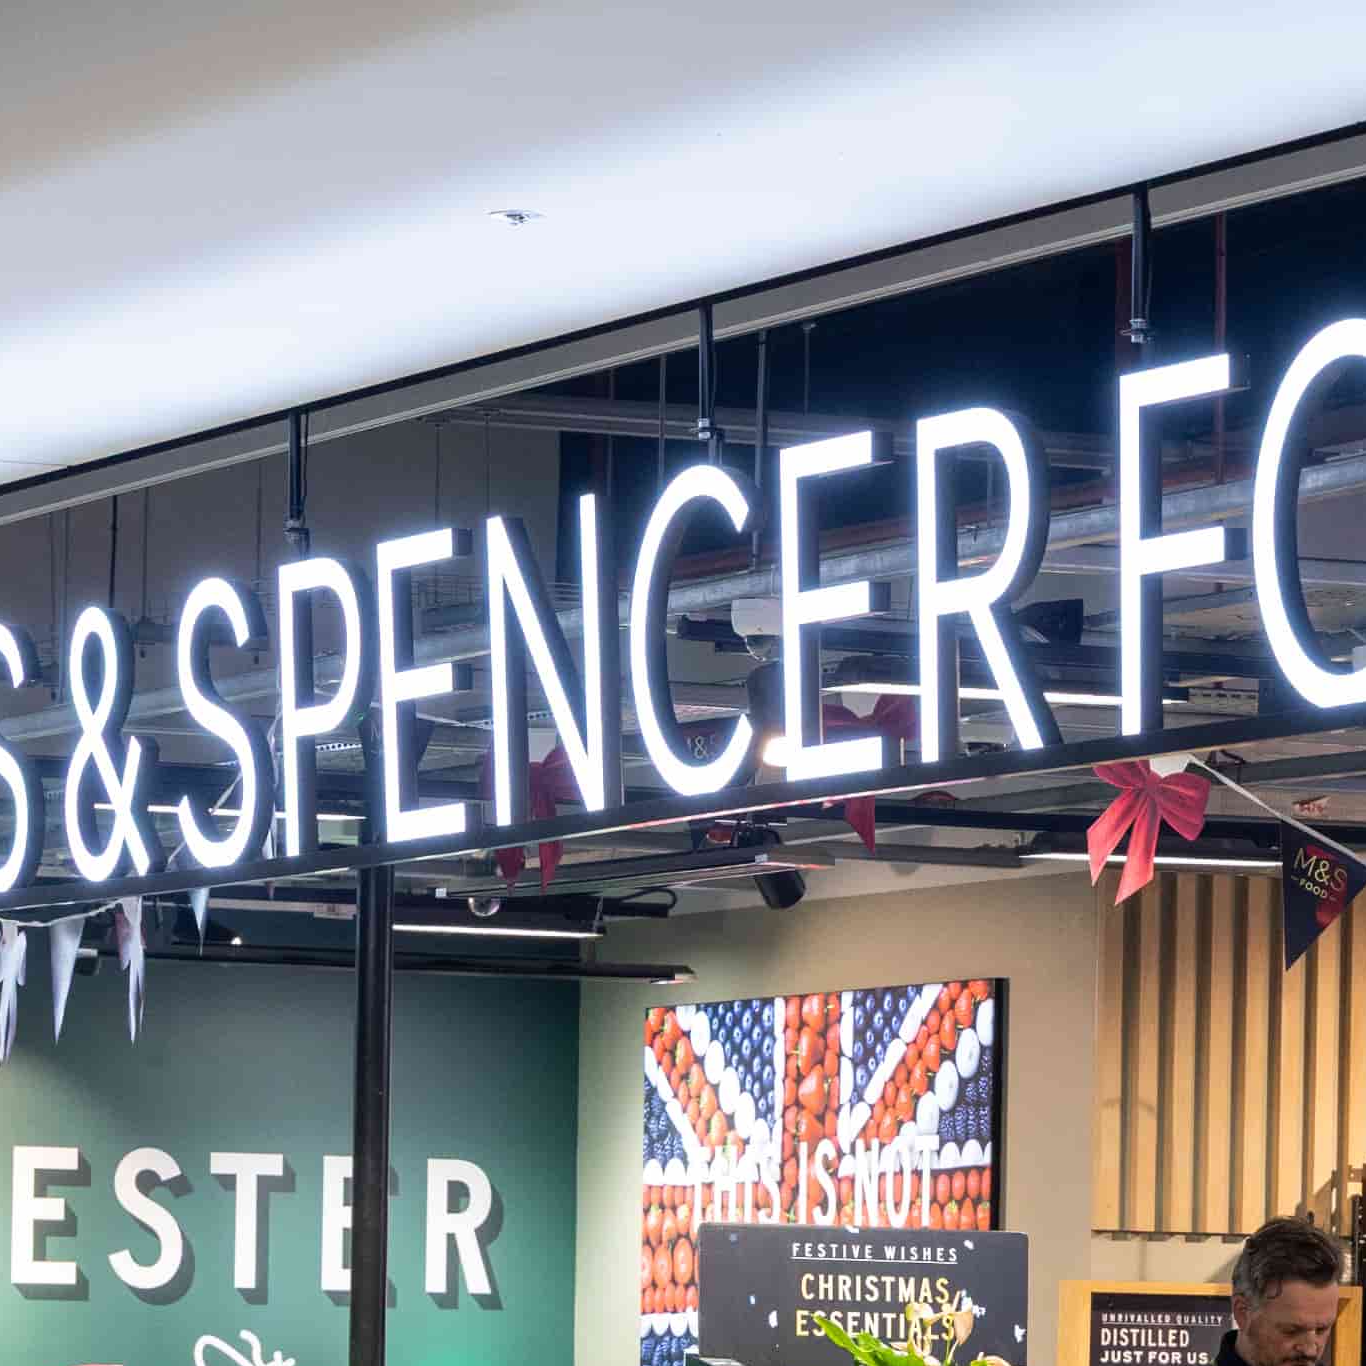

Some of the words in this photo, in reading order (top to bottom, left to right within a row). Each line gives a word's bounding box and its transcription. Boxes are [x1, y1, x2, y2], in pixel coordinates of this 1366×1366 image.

[64, 605, 152, 882] &
[176, 406, 1046, 869] SPENCER
[1294, 847, 1348, 892] M&S
[1299, 878, 1328, 899] FOOD
[688, 1143, 781, 1229] THIS
[798, 1138, 838, 1226] IS
[854, 1134, 940, 1228] NOT
[791, 1242, 874, 1260] FESTIVE
[884, 1245, 958, 1262] WISHES
[800, 1272, 950, 1304] CHRISTMAS
[1101, 1313, 1172, 1323] UNRIVALLED
[1175, 1314, 1223, 1325] QUALITY
[1100, 1327, 1190, 1348] DISTILLED
[1099, 1350, 1143, 1364] JUST
[1147, 1351, 1182, 1364] FOR
[1186, 1352, 1209, 1365] US
